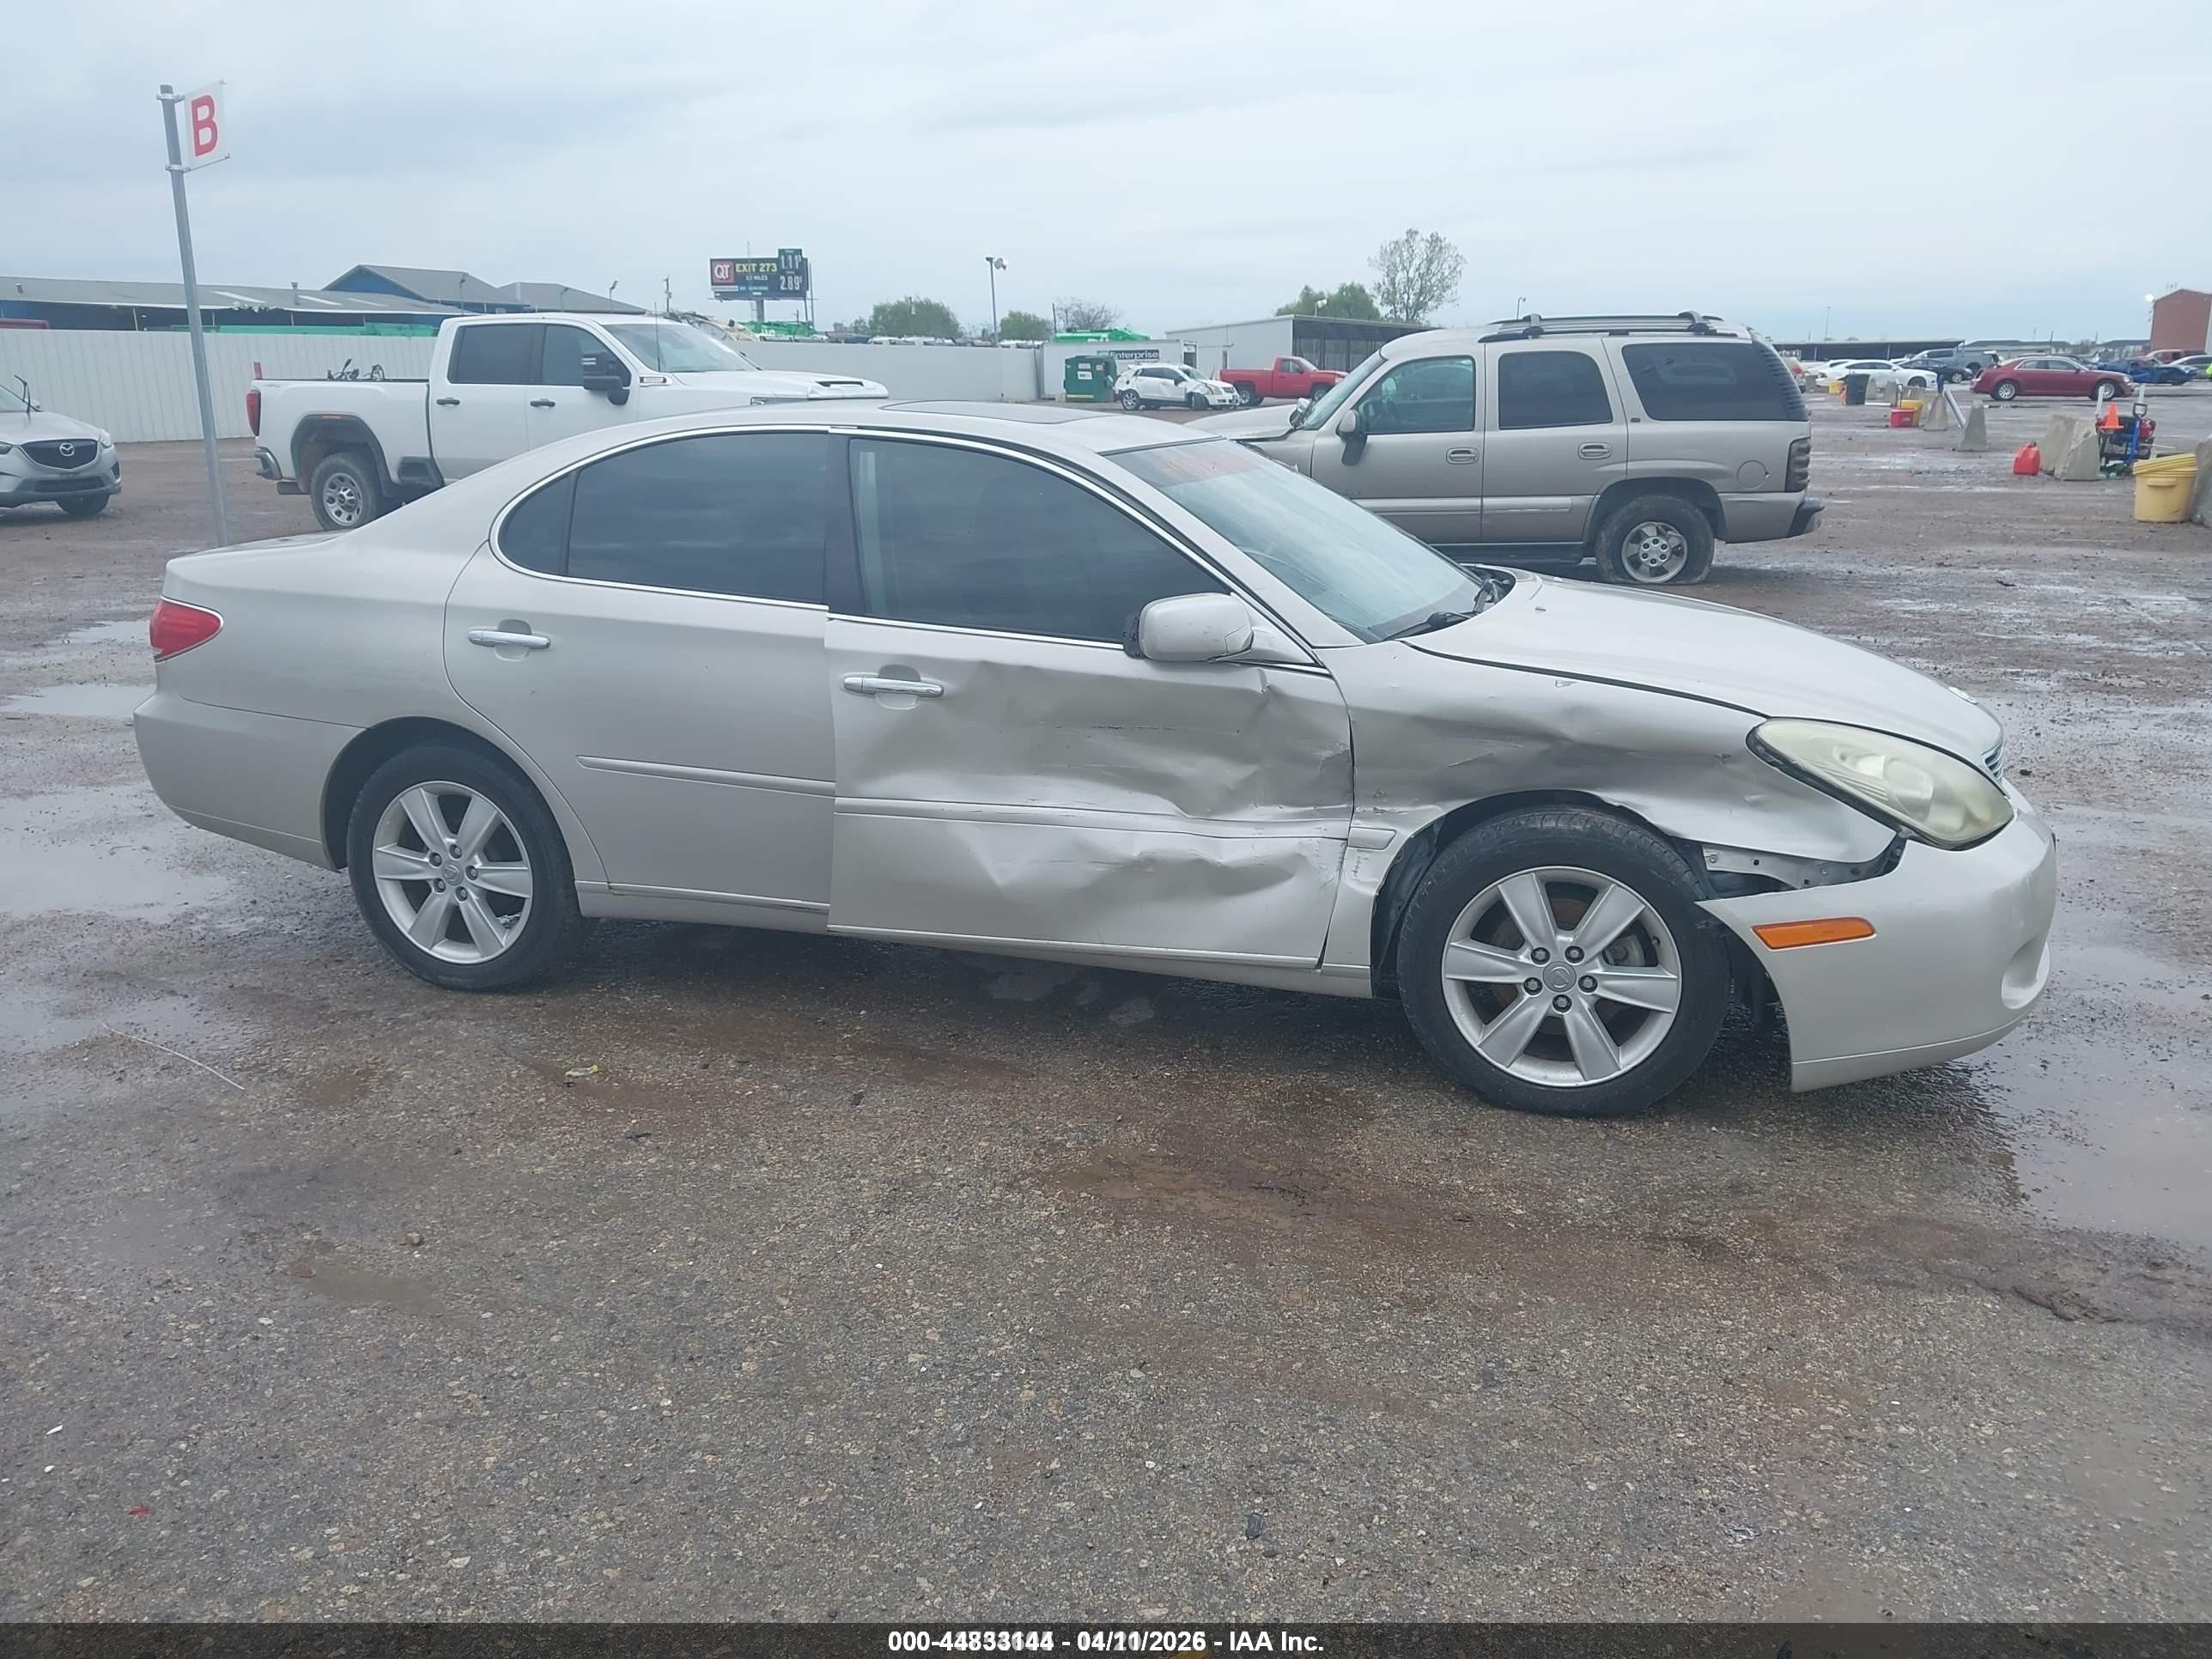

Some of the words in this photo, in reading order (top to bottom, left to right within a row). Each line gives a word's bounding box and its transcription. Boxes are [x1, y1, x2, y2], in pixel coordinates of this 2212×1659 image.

[191, 94, 218, 157] B
[714, 264, 730, 279] QT
[735, 263, 757, 272] EXIT
[759, 263, 777, 272] 273
[1109, 350, 1158, 360] Enterprise
